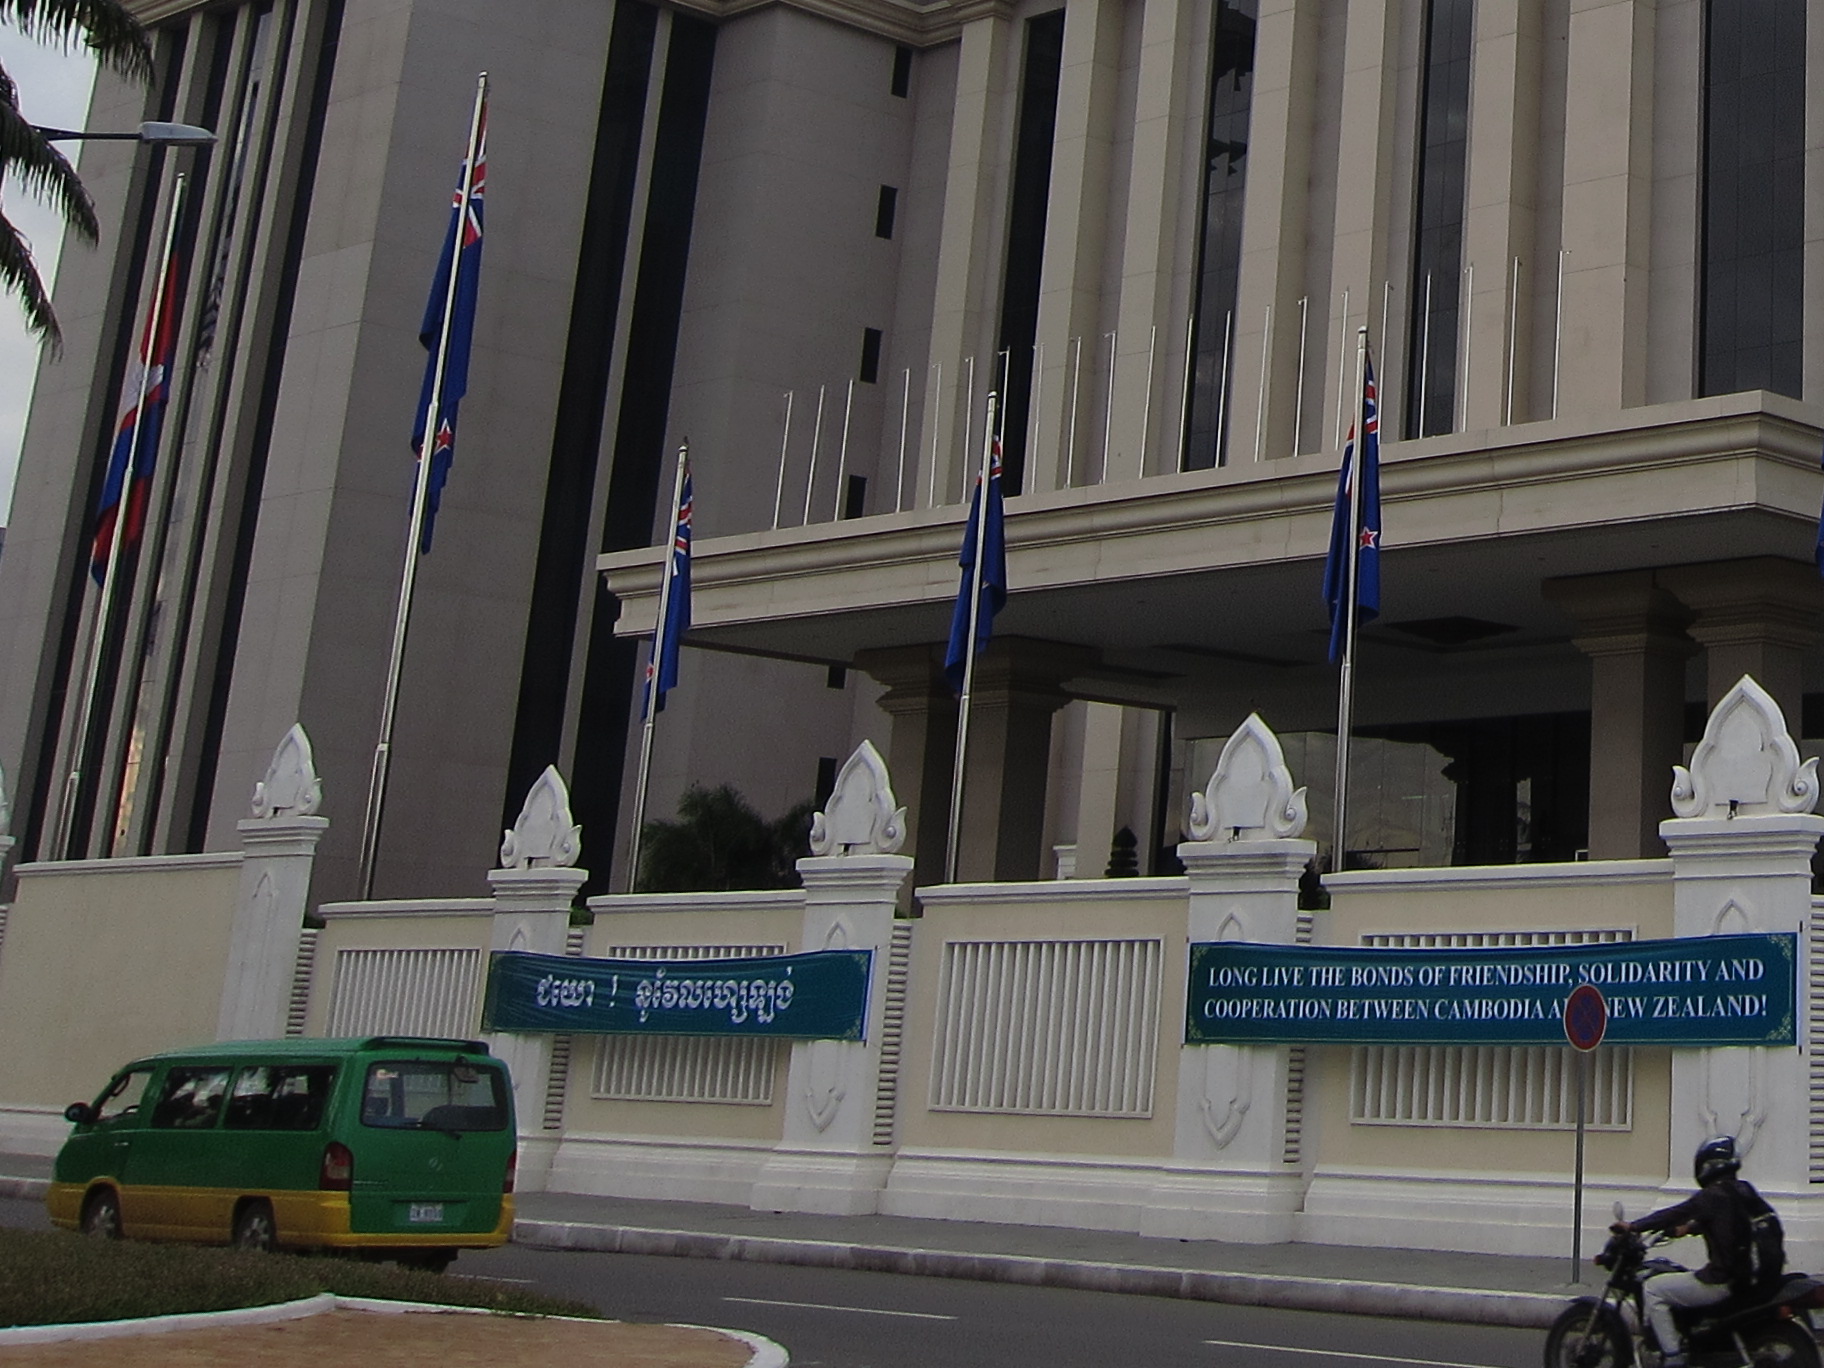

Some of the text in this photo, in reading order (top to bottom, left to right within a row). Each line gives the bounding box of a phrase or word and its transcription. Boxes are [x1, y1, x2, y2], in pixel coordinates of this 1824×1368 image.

[1209, 959, 1764, 987] LONG LIVE THE BONDS OF FRIENDSHIP, SOLIDARITY AND
[1204, 998, 1332, 1019] COOPERATION
[1336, 999, 1429, 1019] BETWEEN
[1435, 999, 1545, 1019] CAMBODIA
[1652, 995, 1768, 1018] ZEALAND!
